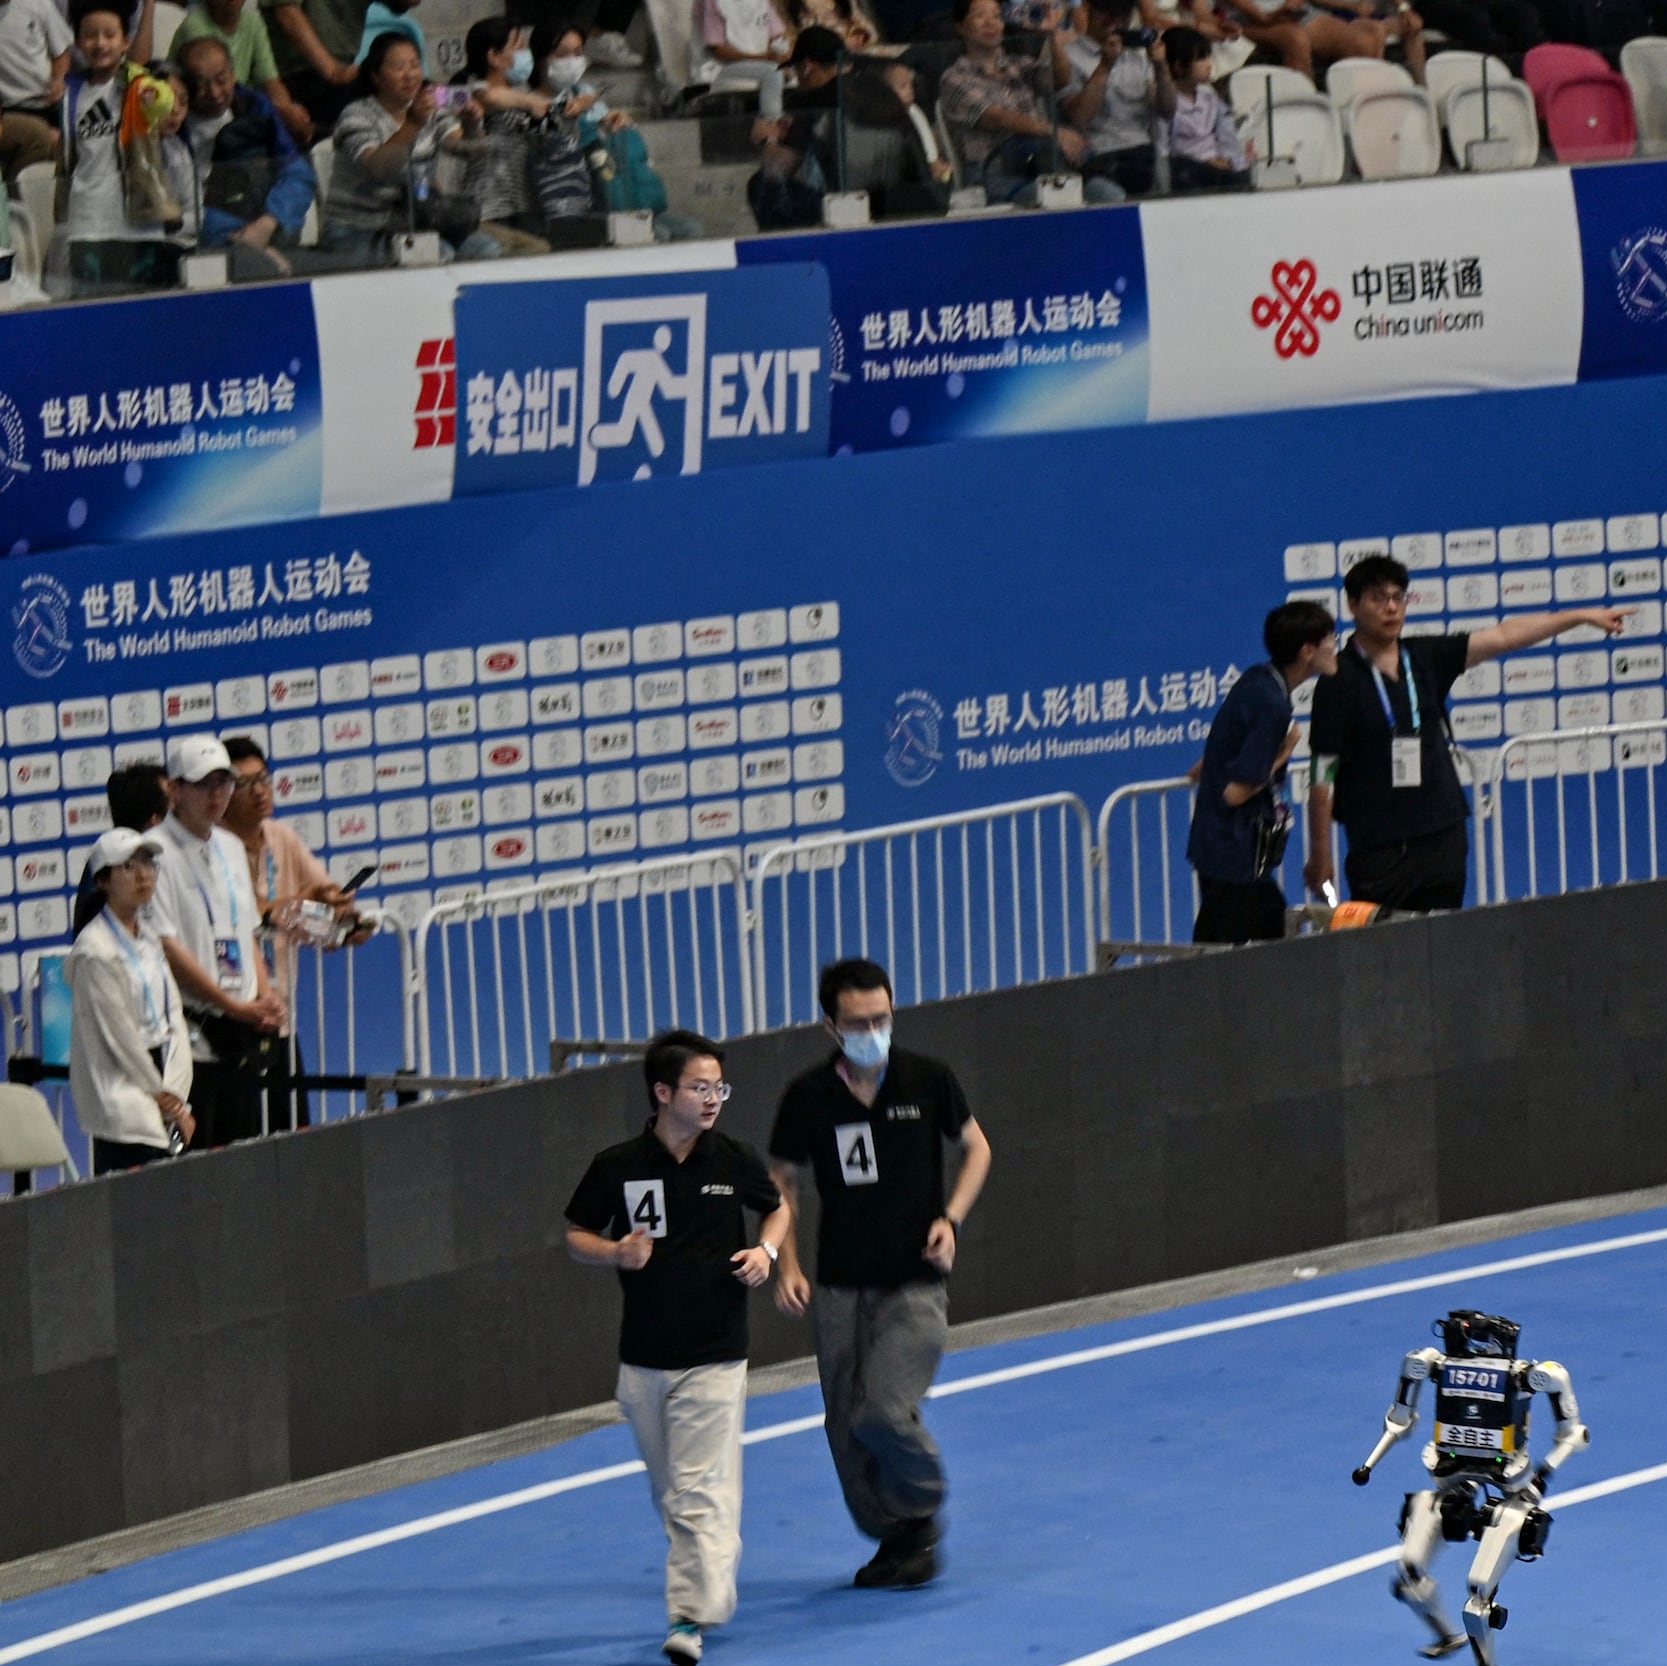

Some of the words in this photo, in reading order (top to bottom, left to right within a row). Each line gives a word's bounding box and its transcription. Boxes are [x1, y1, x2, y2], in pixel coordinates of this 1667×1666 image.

[1353, 257, 1483, 307] 中国联通
[860, 289, 1122, 350] 世界人形机器人运动会
[1354, 313, 1409, 340] China
[1414, 308, 1484, 335] unicom
[862, 360, 890, 382] The
[893, 355, 938, 378] World
[942, 350, 1018, 373] Humanoid
[1022, 344, 1066, 366] Robot
[1071, 340, 1123, 361] Games
[40, 372, 295, 438] 世界人形机器人运动会
[467, 367, 578, 455] 安全出口
[708, 347, 821, 440] EXIT
[42, 449, 69, 471] The
[73, 441, 117, 467] World
[121, 434, 195, 462] Humanoid
[199, 429, 242, 451] Robot
[246, 426, 296, 447] Games
[80, 549, 371, 629] 世界人形机器人运动会
[85, 638, 116, 663] The
[119, 630, 170, 658] World
[174, 618, 258, 651] Humanoid
[262, 612, 311, 638] Robot
[315, 606, 372, 631] Games
[954, 664, 1242, 739] 世界人形机器人运动会
[956, 748, 987, 771] The
[992, 740, 1042, 767] World
[1045, 728, 1130, 760] Humanoid
[1134, 723, 1184, 748] Robot
[846, 1133, 872, 1176] 4
[634, 1189, 662, 1231] 4
[1449, 1369, 1498, 1389] 15701
[1448, 1425, 1494, 1447] 全自主
